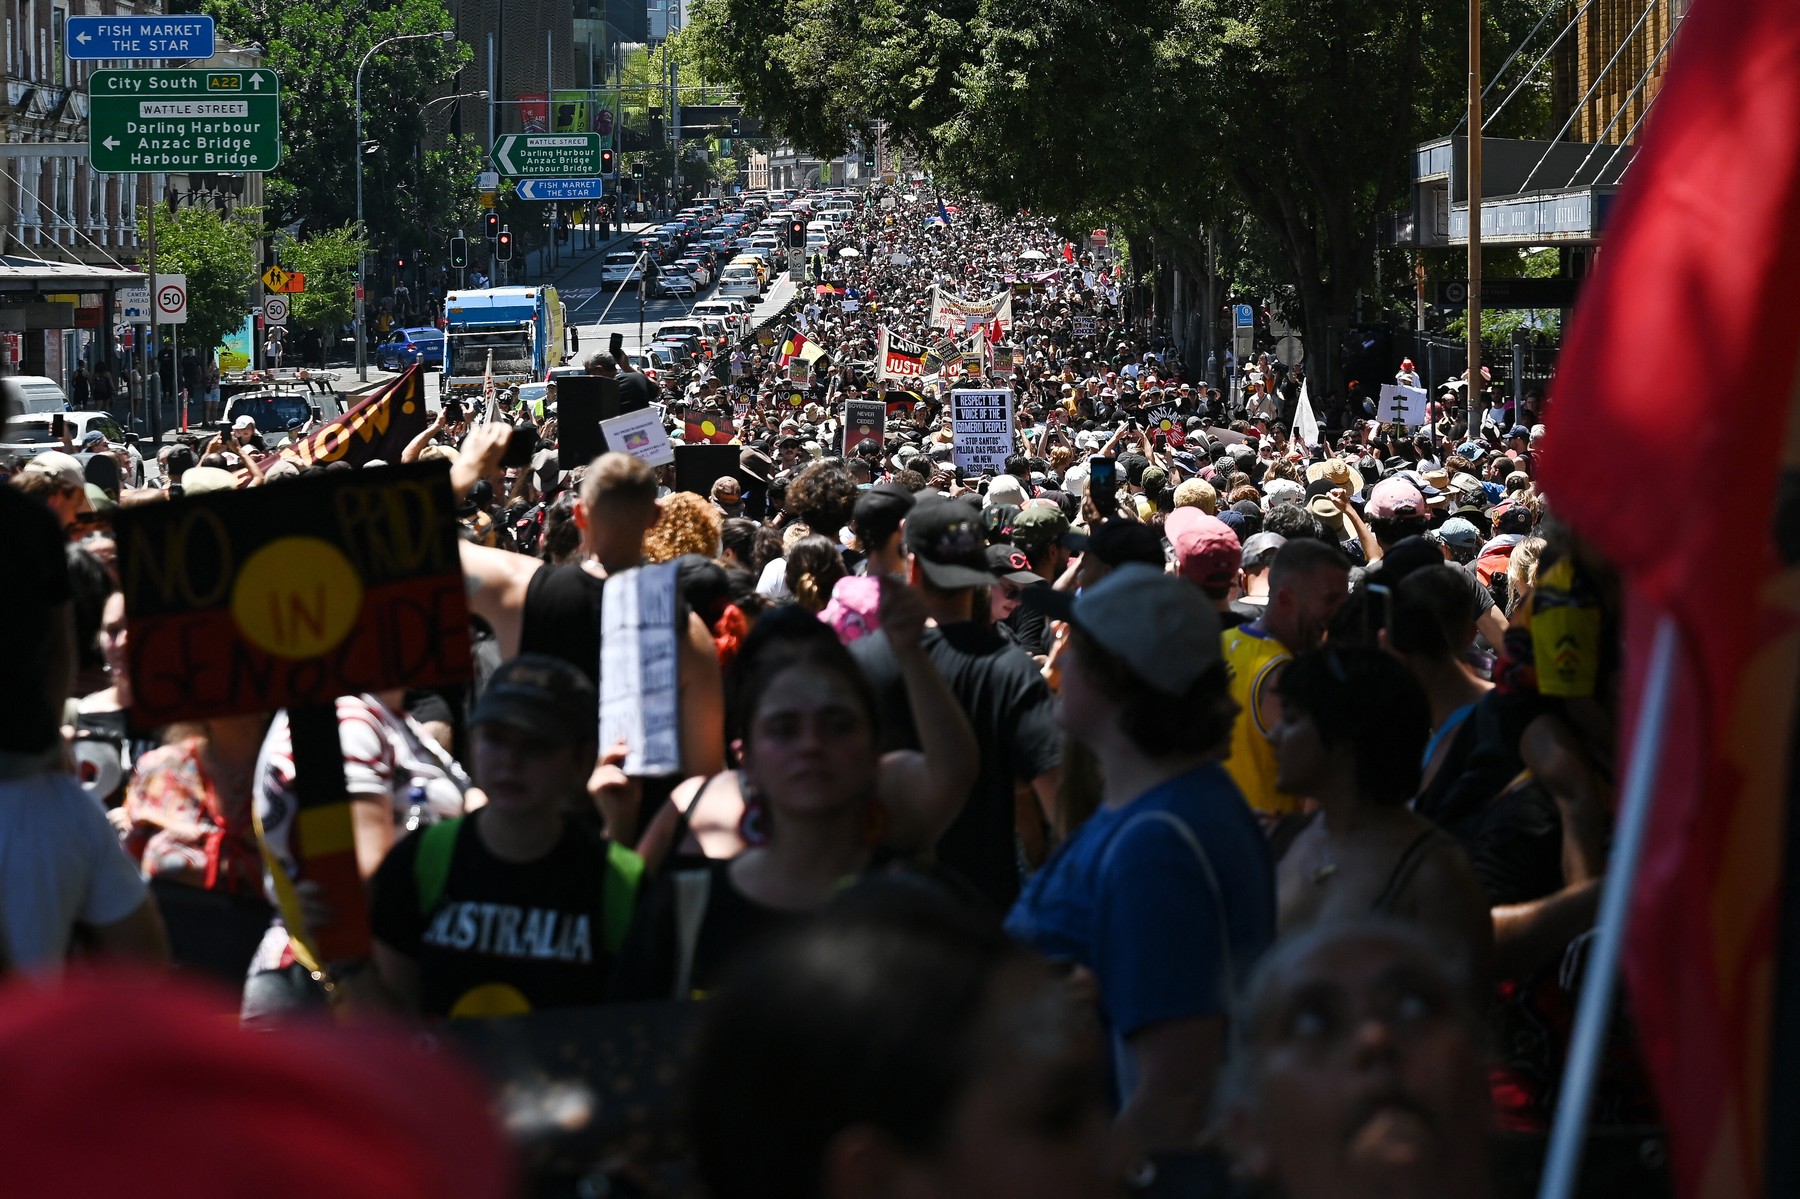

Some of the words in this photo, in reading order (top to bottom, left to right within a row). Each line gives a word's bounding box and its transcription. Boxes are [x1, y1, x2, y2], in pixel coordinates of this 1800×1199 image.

[98, 25, 132, 36] FISH
[140, 24, 202, 36] MARKET
[112, 40, 141, 51] THE
[149, 39, 189, 51] STAR
[107, 76, 141, 91] City
[148, 76, 198, 90] South
[211, 77, 239, 88] A22
[143, 103, 192, 115] WATTLE
[196, 103, 244, 114] STREET
[126, 121, 186, 136] Darling
[191, 121, 261, 133] Harbour
[138, 137, 191, 149] Anzac
[197, 137, 251, 152] Bridge
[130, 152, 199, 165] Harbour
[204, 152, 258, 167] Bridge
[520, 149, 554, 159] Darling
[559, 156, 590, 166] Bridge
[522, 165, 560, 173] Harbour
[563, 164, 593, 174] Bridge
[1555, 206, 1582, 223] AUSTRALIA
[163, 293, 180, 306] 50
[270, 305, 282, 314] 50
[890, 336, 921, 354] LAND
[886, 358, 924, 374] JUSTI
[778, 391, 790, 400] NO
[960, 395, 986, 406] RESPECT
[987, 395, 1000, 406] THE
[961, 408, 978, 420] VOICE
[979, 408, 987, 420] OF
[988, 408, 1001, 420] THE
[956, 422, 984, 433] GOMEROI
[984, 422, 1006, 432] PEOPLE
[966, 437, 978, 445] STOP
[956, 446, 974, 454] PILLIGA
[975, 446, 987, 454] GAS
[987, 446, 1008, 454] PROJECT
[128, 506, 233, 612] NO
[268, 582, 327, 645] IN
[132, 580, 470, 715] GENOCIDE
